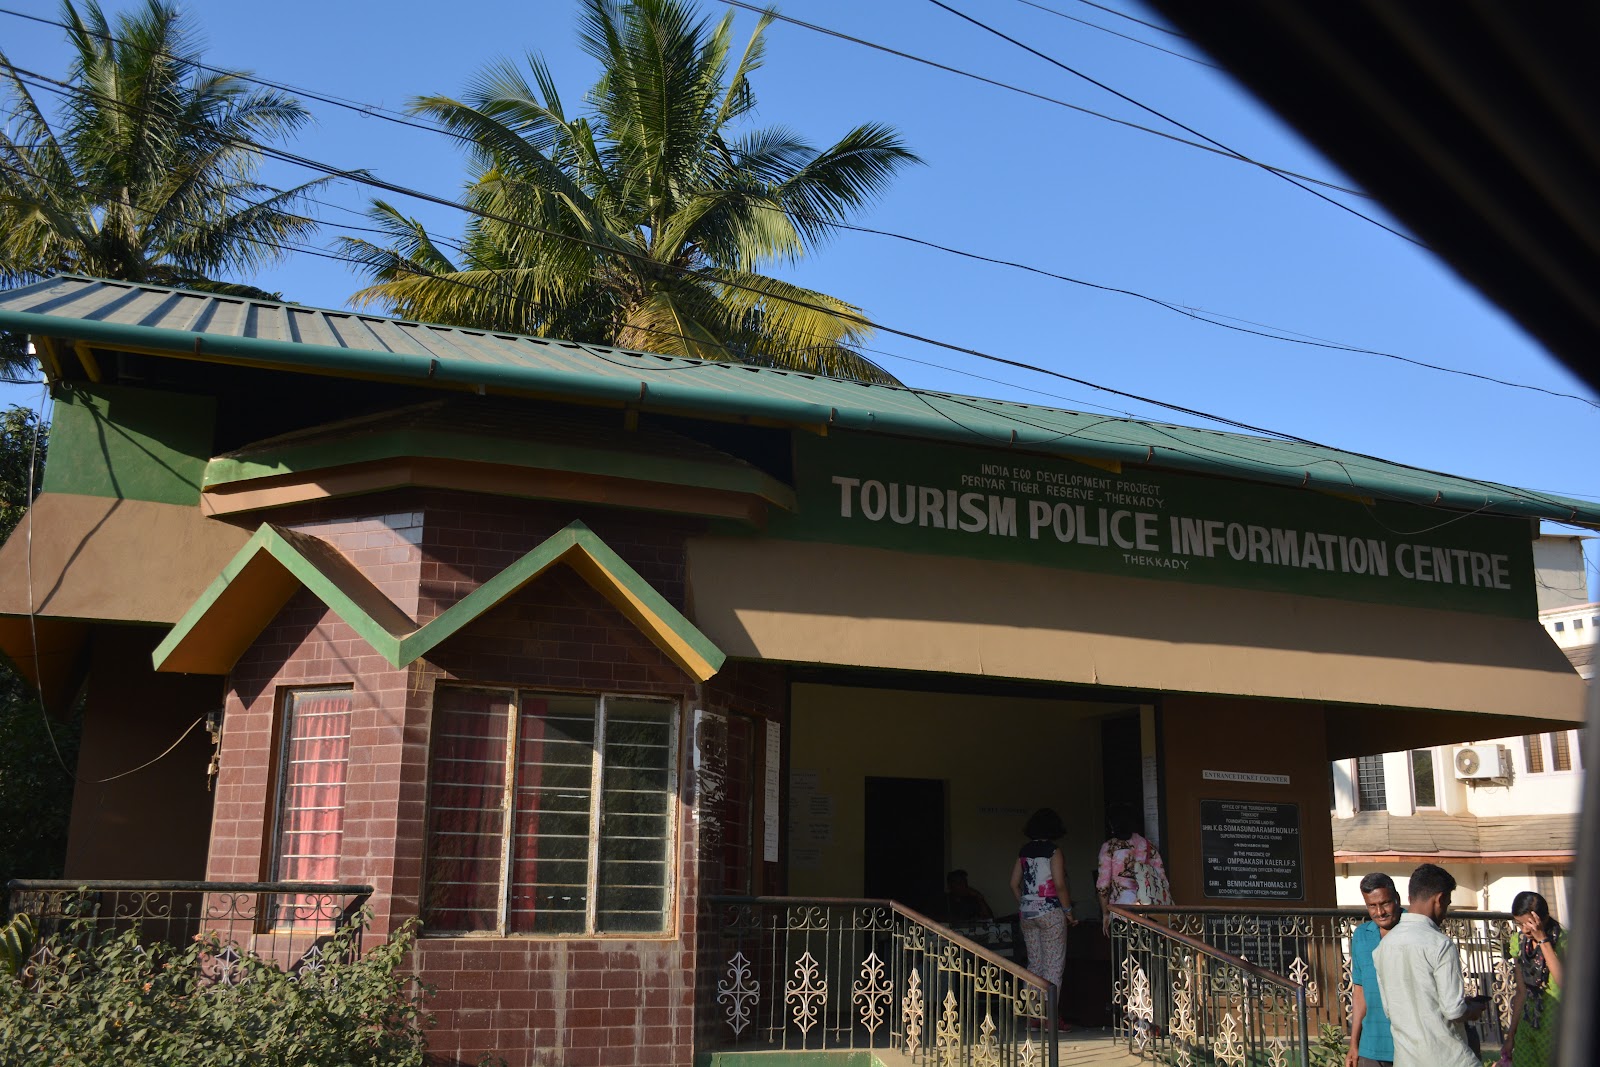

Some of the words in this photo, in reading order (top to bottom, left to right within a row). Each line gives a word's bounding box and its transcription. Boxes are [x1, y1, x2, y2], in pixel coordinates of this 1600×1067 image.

[961, 475, 1006, 491] PERIYAR
[1011, 480, 1040, 494] TIGER
[1047, 486, 1094, 500] RESERVE
[981, 463, 1009, 477] INDIA
[1036, 470, 1111, 490] DEVELOPMENT
[1117, 481, 1160, 496] PROJECT
[831, 475, 1017, 537] TOURISM
[1029, 499, 1160, 552] POLICE
[1169, 515, 1389, 577] INFORMATION
[1395, 543, 1511, 590] CENTRE
